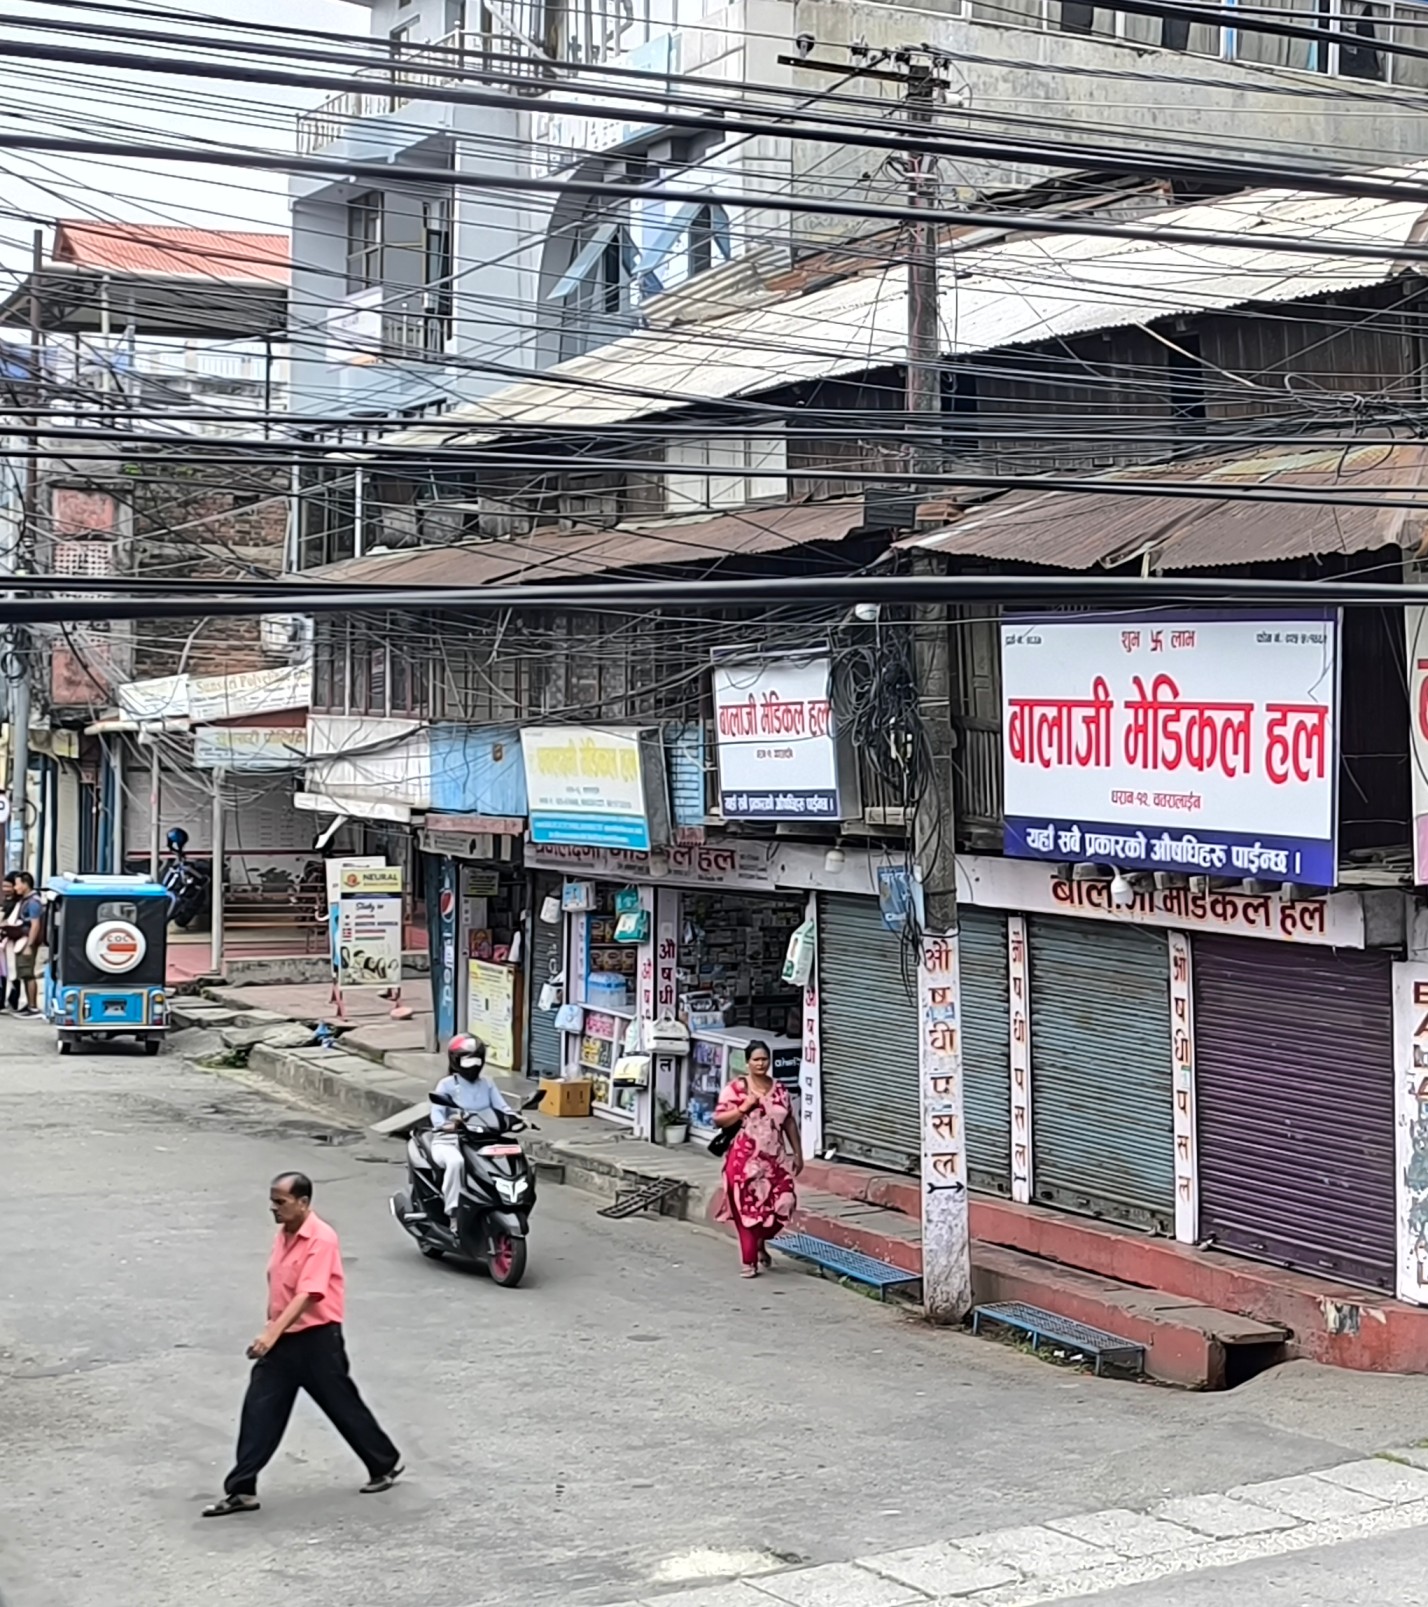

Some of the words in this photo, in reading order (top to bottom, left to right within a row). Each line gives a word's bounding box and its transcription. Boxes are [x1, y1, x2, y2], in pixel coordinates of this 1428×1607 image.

[719, 693, 757, 737] बालाजी
[760, 690, 804, 735] मेडिकल
[807, 699, 831, 737] हल
[1008, 676, 1113, 769] बालाजी
[1124, 673, 1254, 778] मेडिकल
[1265, 702, 1329, 785] हल
[698, 847, 736, 872] हल
[1058, 826, 1082, 853] सबै
[1085, 830, 1147, 860] प्रकारको
[363, 873, 398, 881] NEURAL
[1280, 893, 1328, 936] हल
